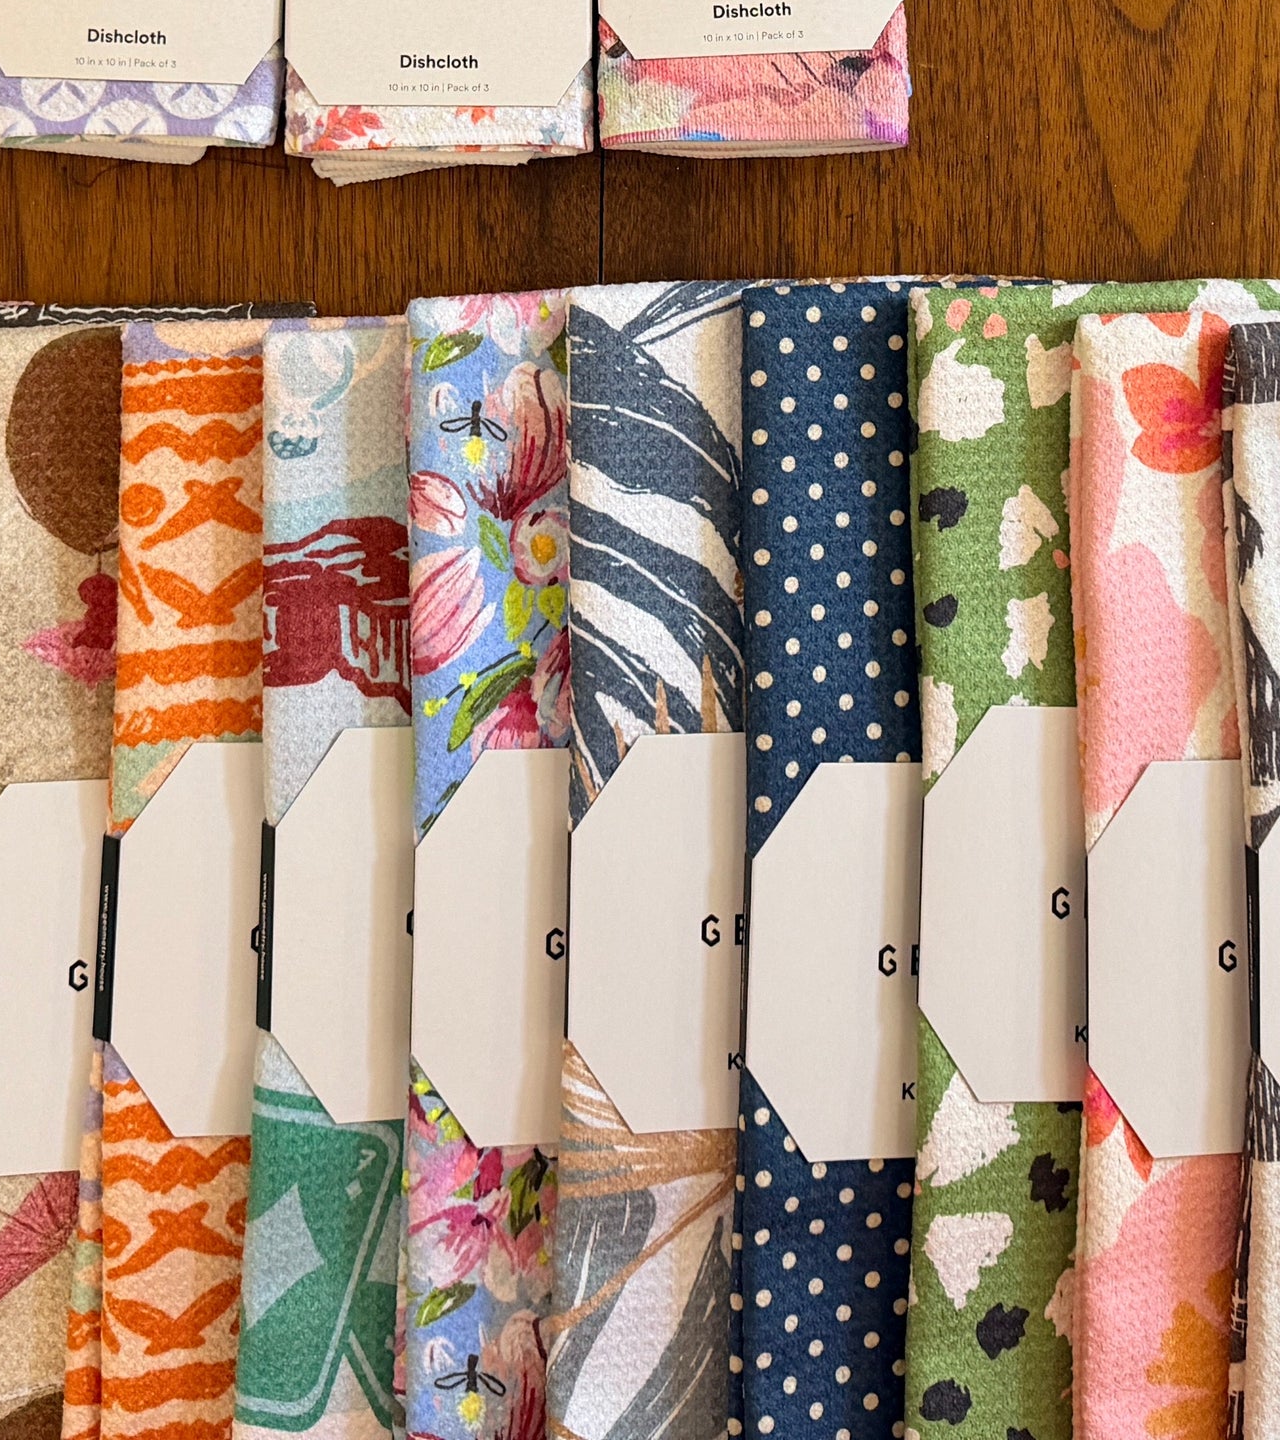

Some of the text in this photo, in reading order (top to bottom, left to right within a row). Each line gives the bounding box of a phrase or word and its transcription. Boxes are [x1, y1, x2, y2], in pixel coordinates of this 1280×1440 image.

[713, 1, 791, 19] Dishcloth
[87, 28, 166, 45] Dishcloth
[702, 33, 713, 43] 10
[714, 33, 724, 42] in
[733, 32, 744, 41] 10
[745, 33, 755, 41] in
[761, 30, 784, 40] Pack
[785, 29, 795, 39] of
[797, 29, 804, 39] 3
[400, 54, 478, 69] Dishcloth
